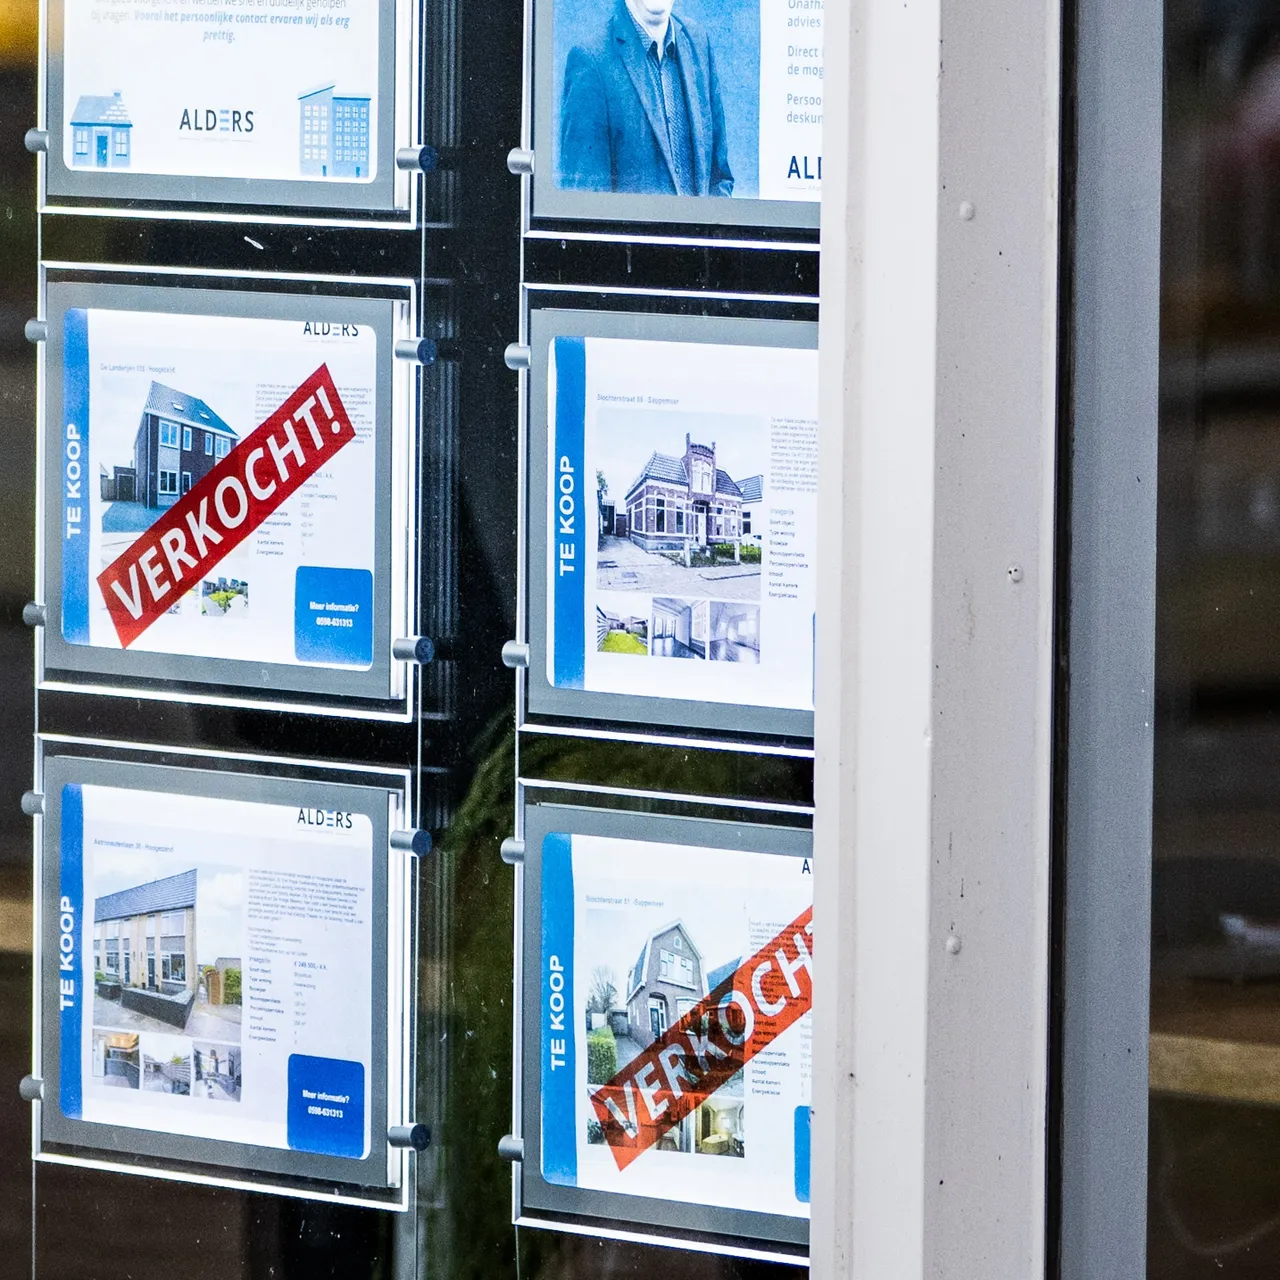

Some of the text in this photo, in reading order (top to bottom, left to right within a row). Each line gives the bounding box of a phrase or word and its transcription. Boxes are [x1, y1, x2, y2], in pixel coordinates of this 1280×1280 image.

[134, 10, 162, 21] Vooral
[164, 10, 178, 22] het
[180, 11, 233, 25] persoonlijke
[235, 13, 268, 24] contact
[270, 15, 303, 25] ervaren
[305, 13, 318, 28] wij
[320, 13, 333, 26] als
[335, 16, 350, 30] erg
[787, 15, 821, 28] advies
[203, 30, 236, 44] prettig.
[788, 45, 819, 58] Direct
[787, 63, 799, 75] de
[787, 93, 822, 106] Persoo
[179, 108, 254, 133] ALDERS
[303, 321, 359, 337] ALDERS
[66, 423, 82, 540] TE KOOP
[111, 385, 341, 621] VERKOCHT!
[559, 456, 575, 577] TE KOOP
[309, 601, 360, 613] Meer informatie?
[297, 808, 353, 829] ALDERS
[59, 895, 75, 1011] TE KOOP
[549, 955, 565, 1071] TE KOOP
[302, 1089, 350, 1104] Meer informatie?
